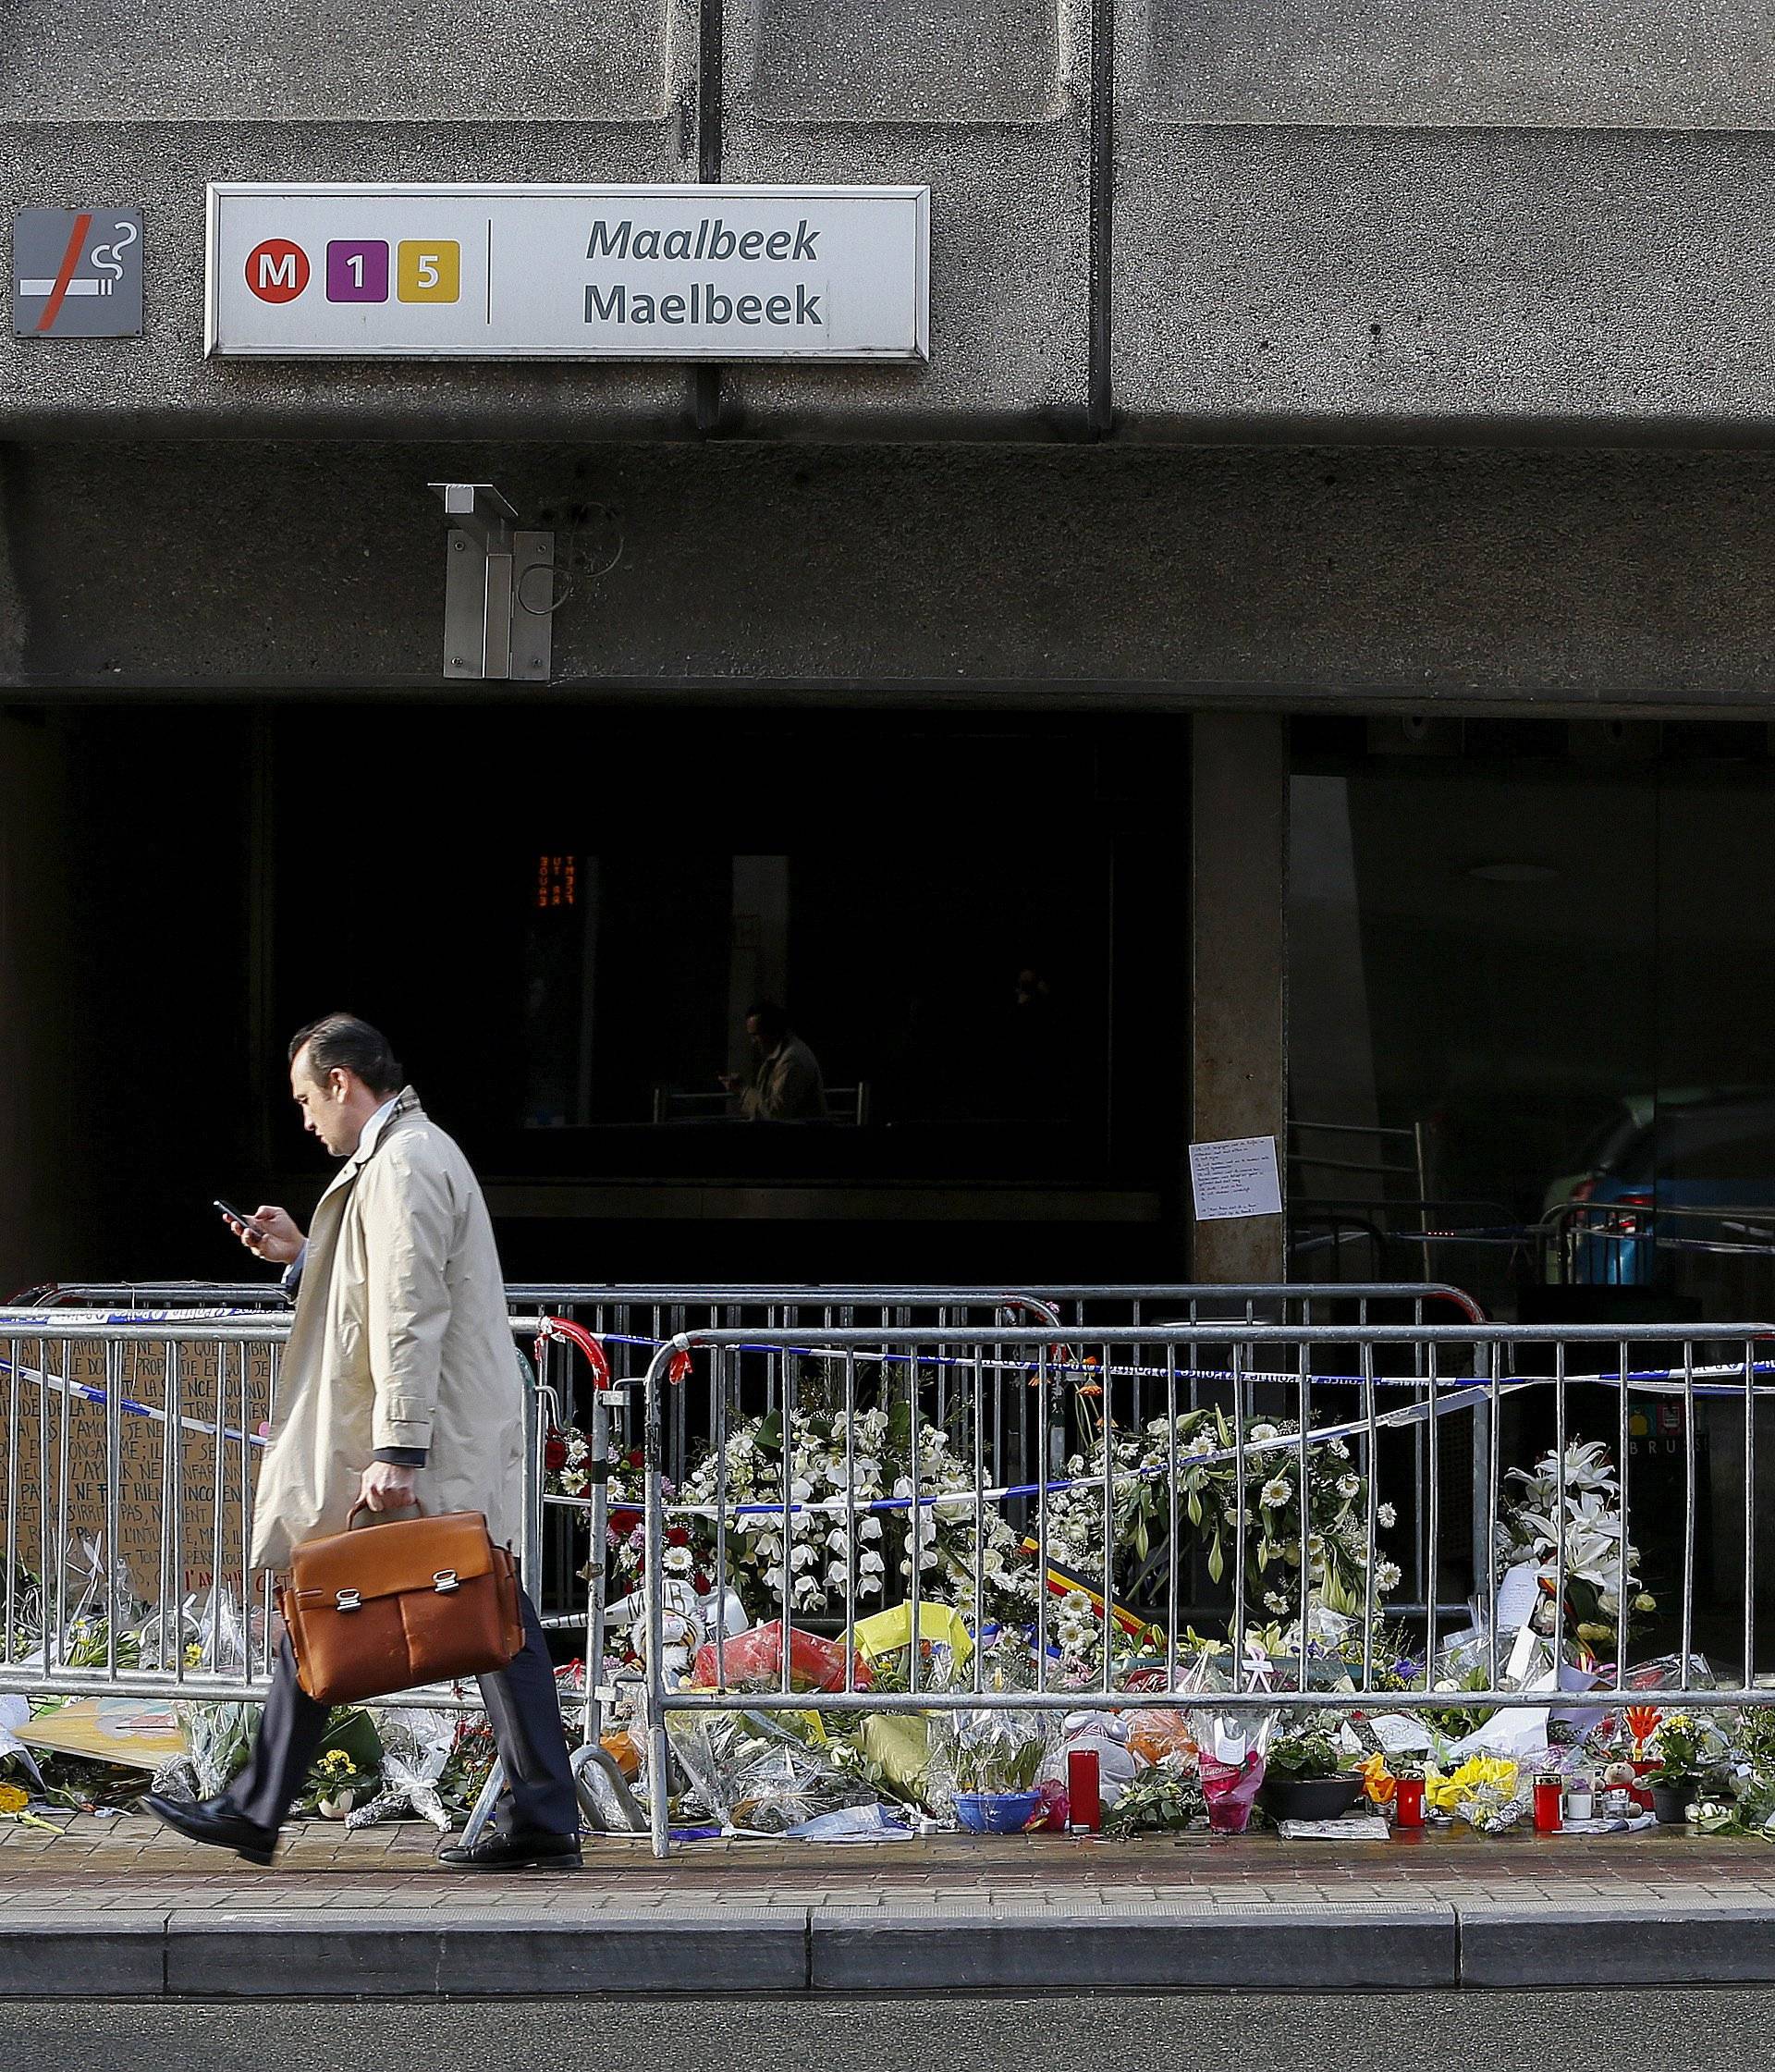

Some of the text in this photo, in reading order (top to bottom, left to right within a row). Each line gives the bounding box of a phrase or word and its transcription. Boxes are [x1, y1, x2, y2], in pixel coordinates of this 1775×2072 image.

[586, 219, 820, 262] Maalbeek
[257, 251, 439, 290] M 1 5
[584, 284, 822, 325] Maelbeek
